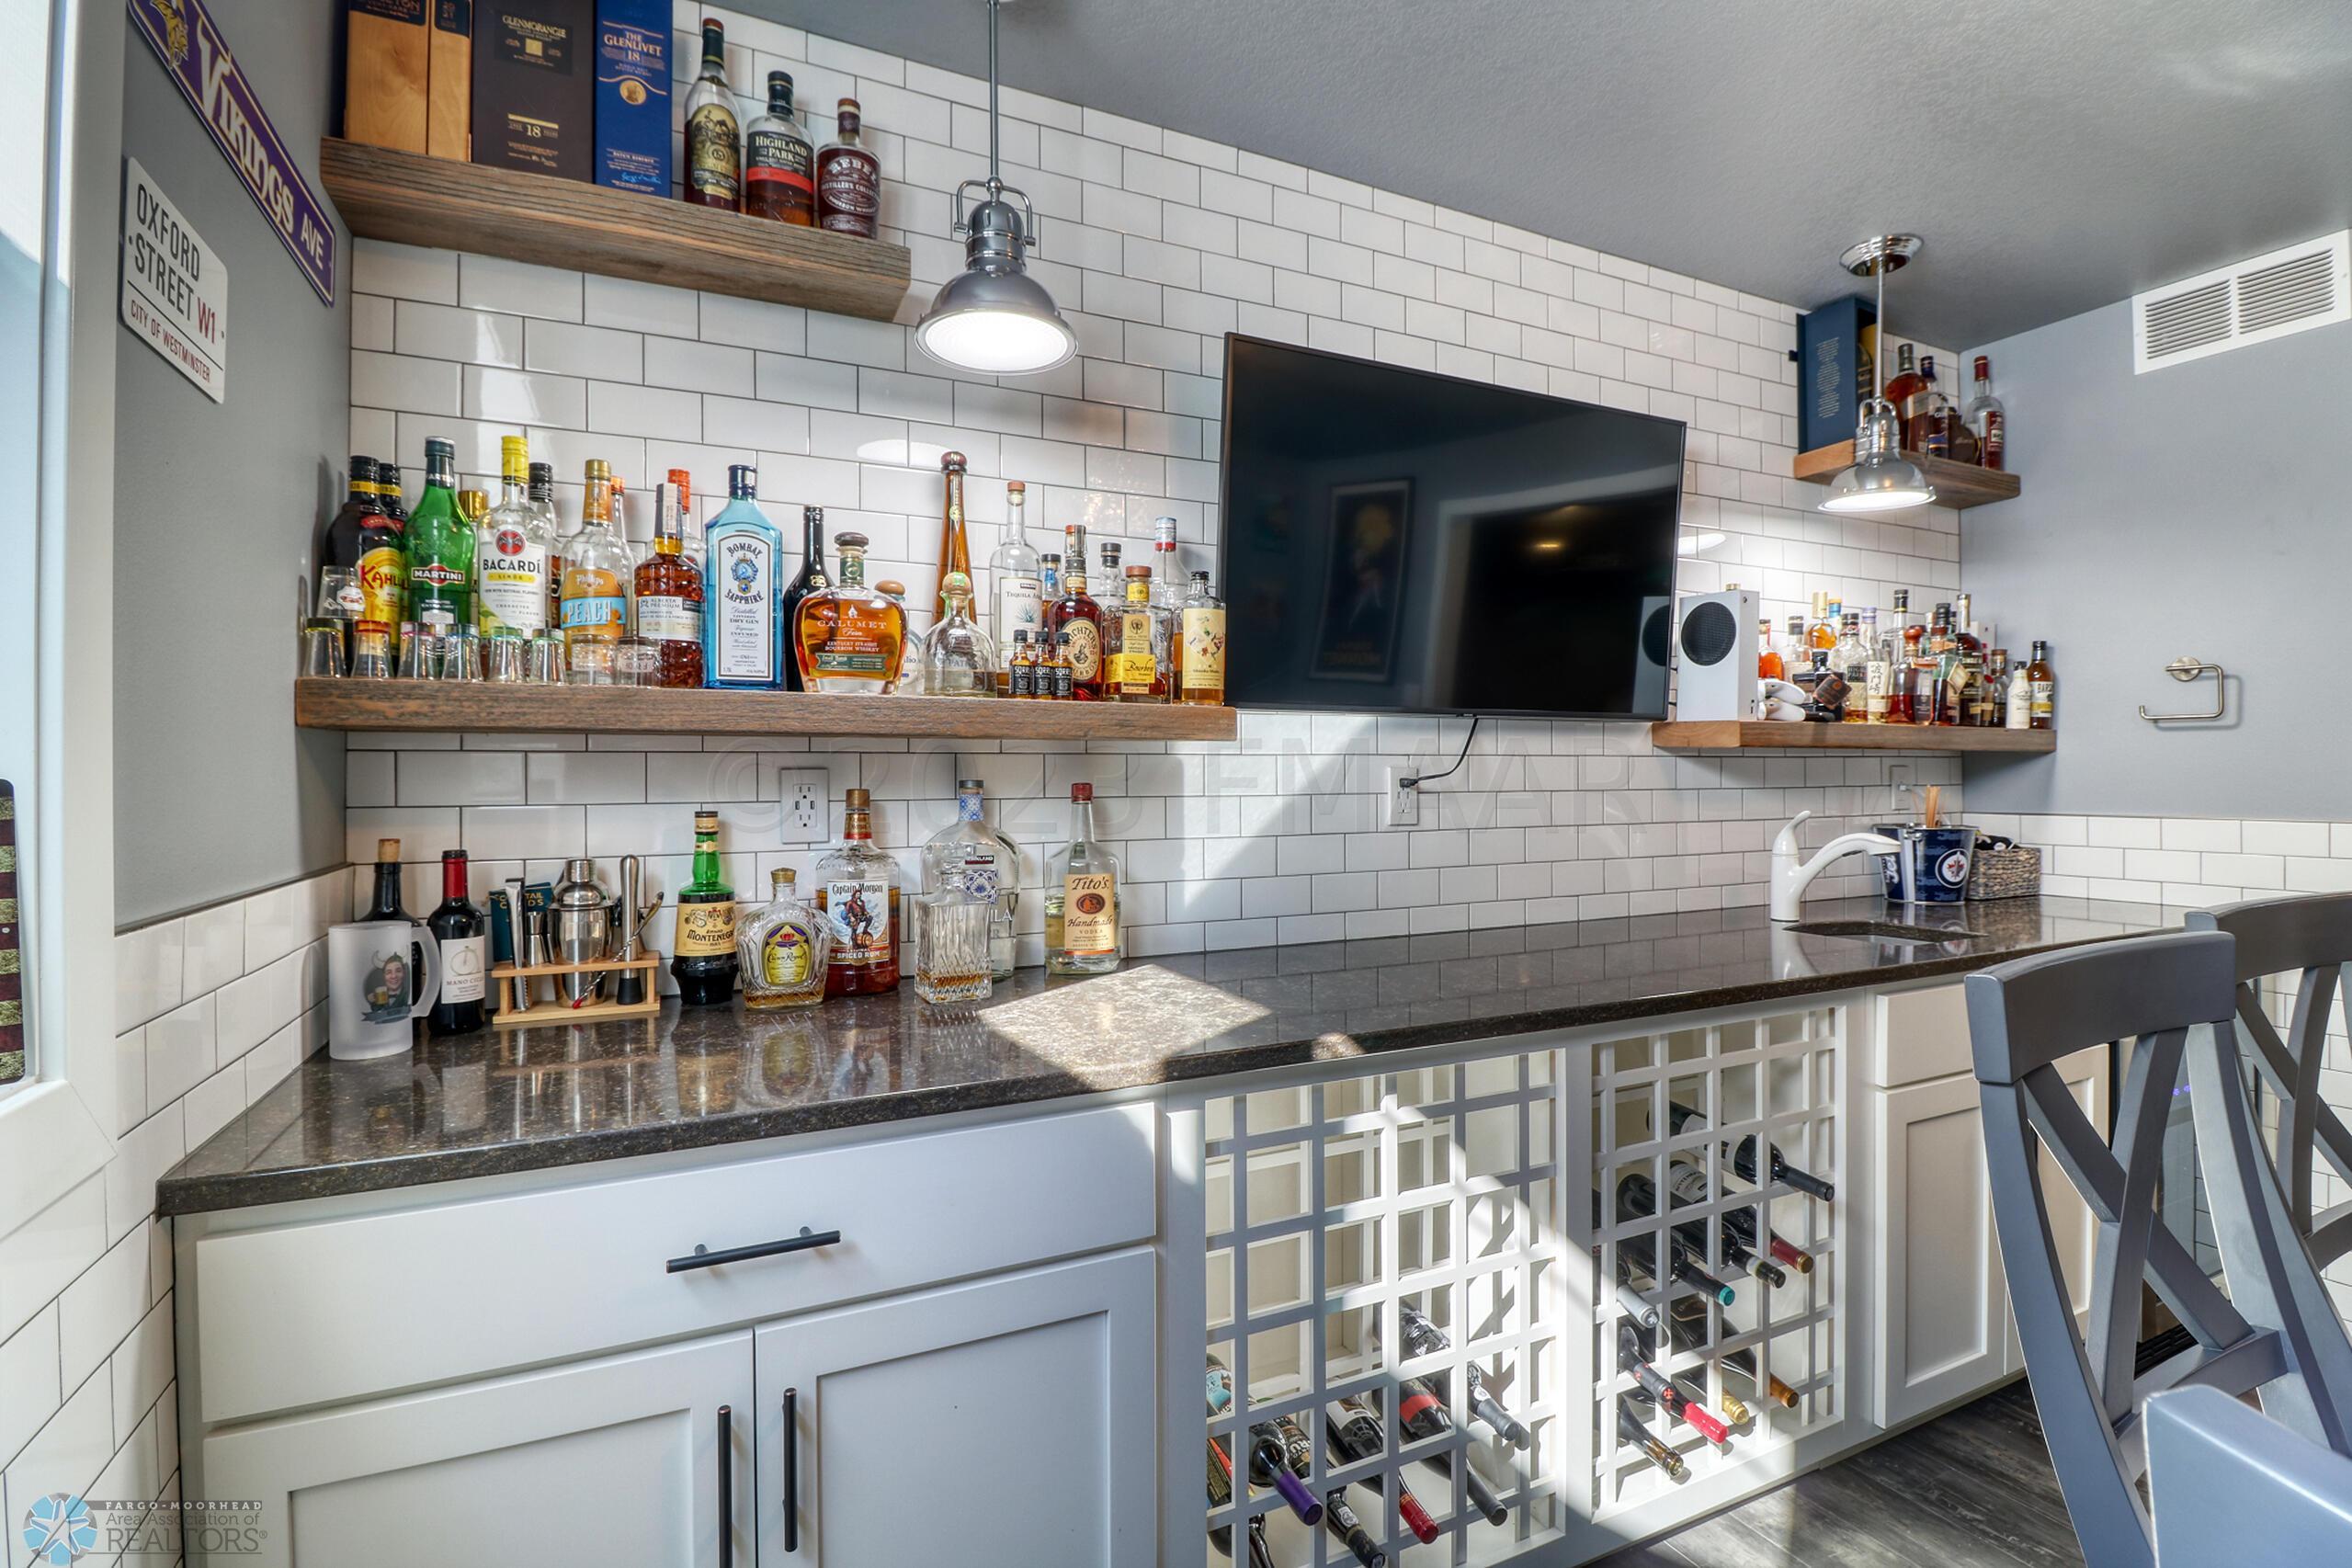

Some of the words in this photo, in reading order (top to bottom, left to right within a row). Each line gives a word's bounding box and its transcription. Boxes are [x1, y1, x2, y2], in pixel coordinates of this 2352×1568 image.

[502, 15, 567, 39] GLENMORANGIE
[625, 30, 642, 42] THE
[604, 34, 663, 56] GLENLIVET
[628, 51, 641, 62] 18
[526, 124, 541, 138] 18
[196, 18, 294, 236] VIKINGS
[301, 212, 324, 269] AVE
[755, 135, 808, 156] HIGHLAND
[768, 147, 796, 162] PARK
[137, 183, 200, 282] OXFORD
[134, 233, 194, 323] STREET
[197, 295, 217, 346] W1
[131, 299, 149, 329] CITY
[151, 318, 162, 341] OF
[163, 332, 210, 383] WESTMINSTER
[726, 542, 763, 558] BOMBAY
[483, 559, 540, 574] BACARDÍ
[414, 569, 463, 581] MARTINI
[724, 588, 764, 604] SAPPHIRE
[567, 600, 612, 623] PEACH
[817, 620, 887, 630] CALUMET
[1124, 658, 1153, 671] Bourbon
[832, 883, 856, 895] Captain
[858, 882, 883, 894] Morgan
[1072, 876, 1109, 890] Tito's
[1067, 915, 1113, 927] Handmade
